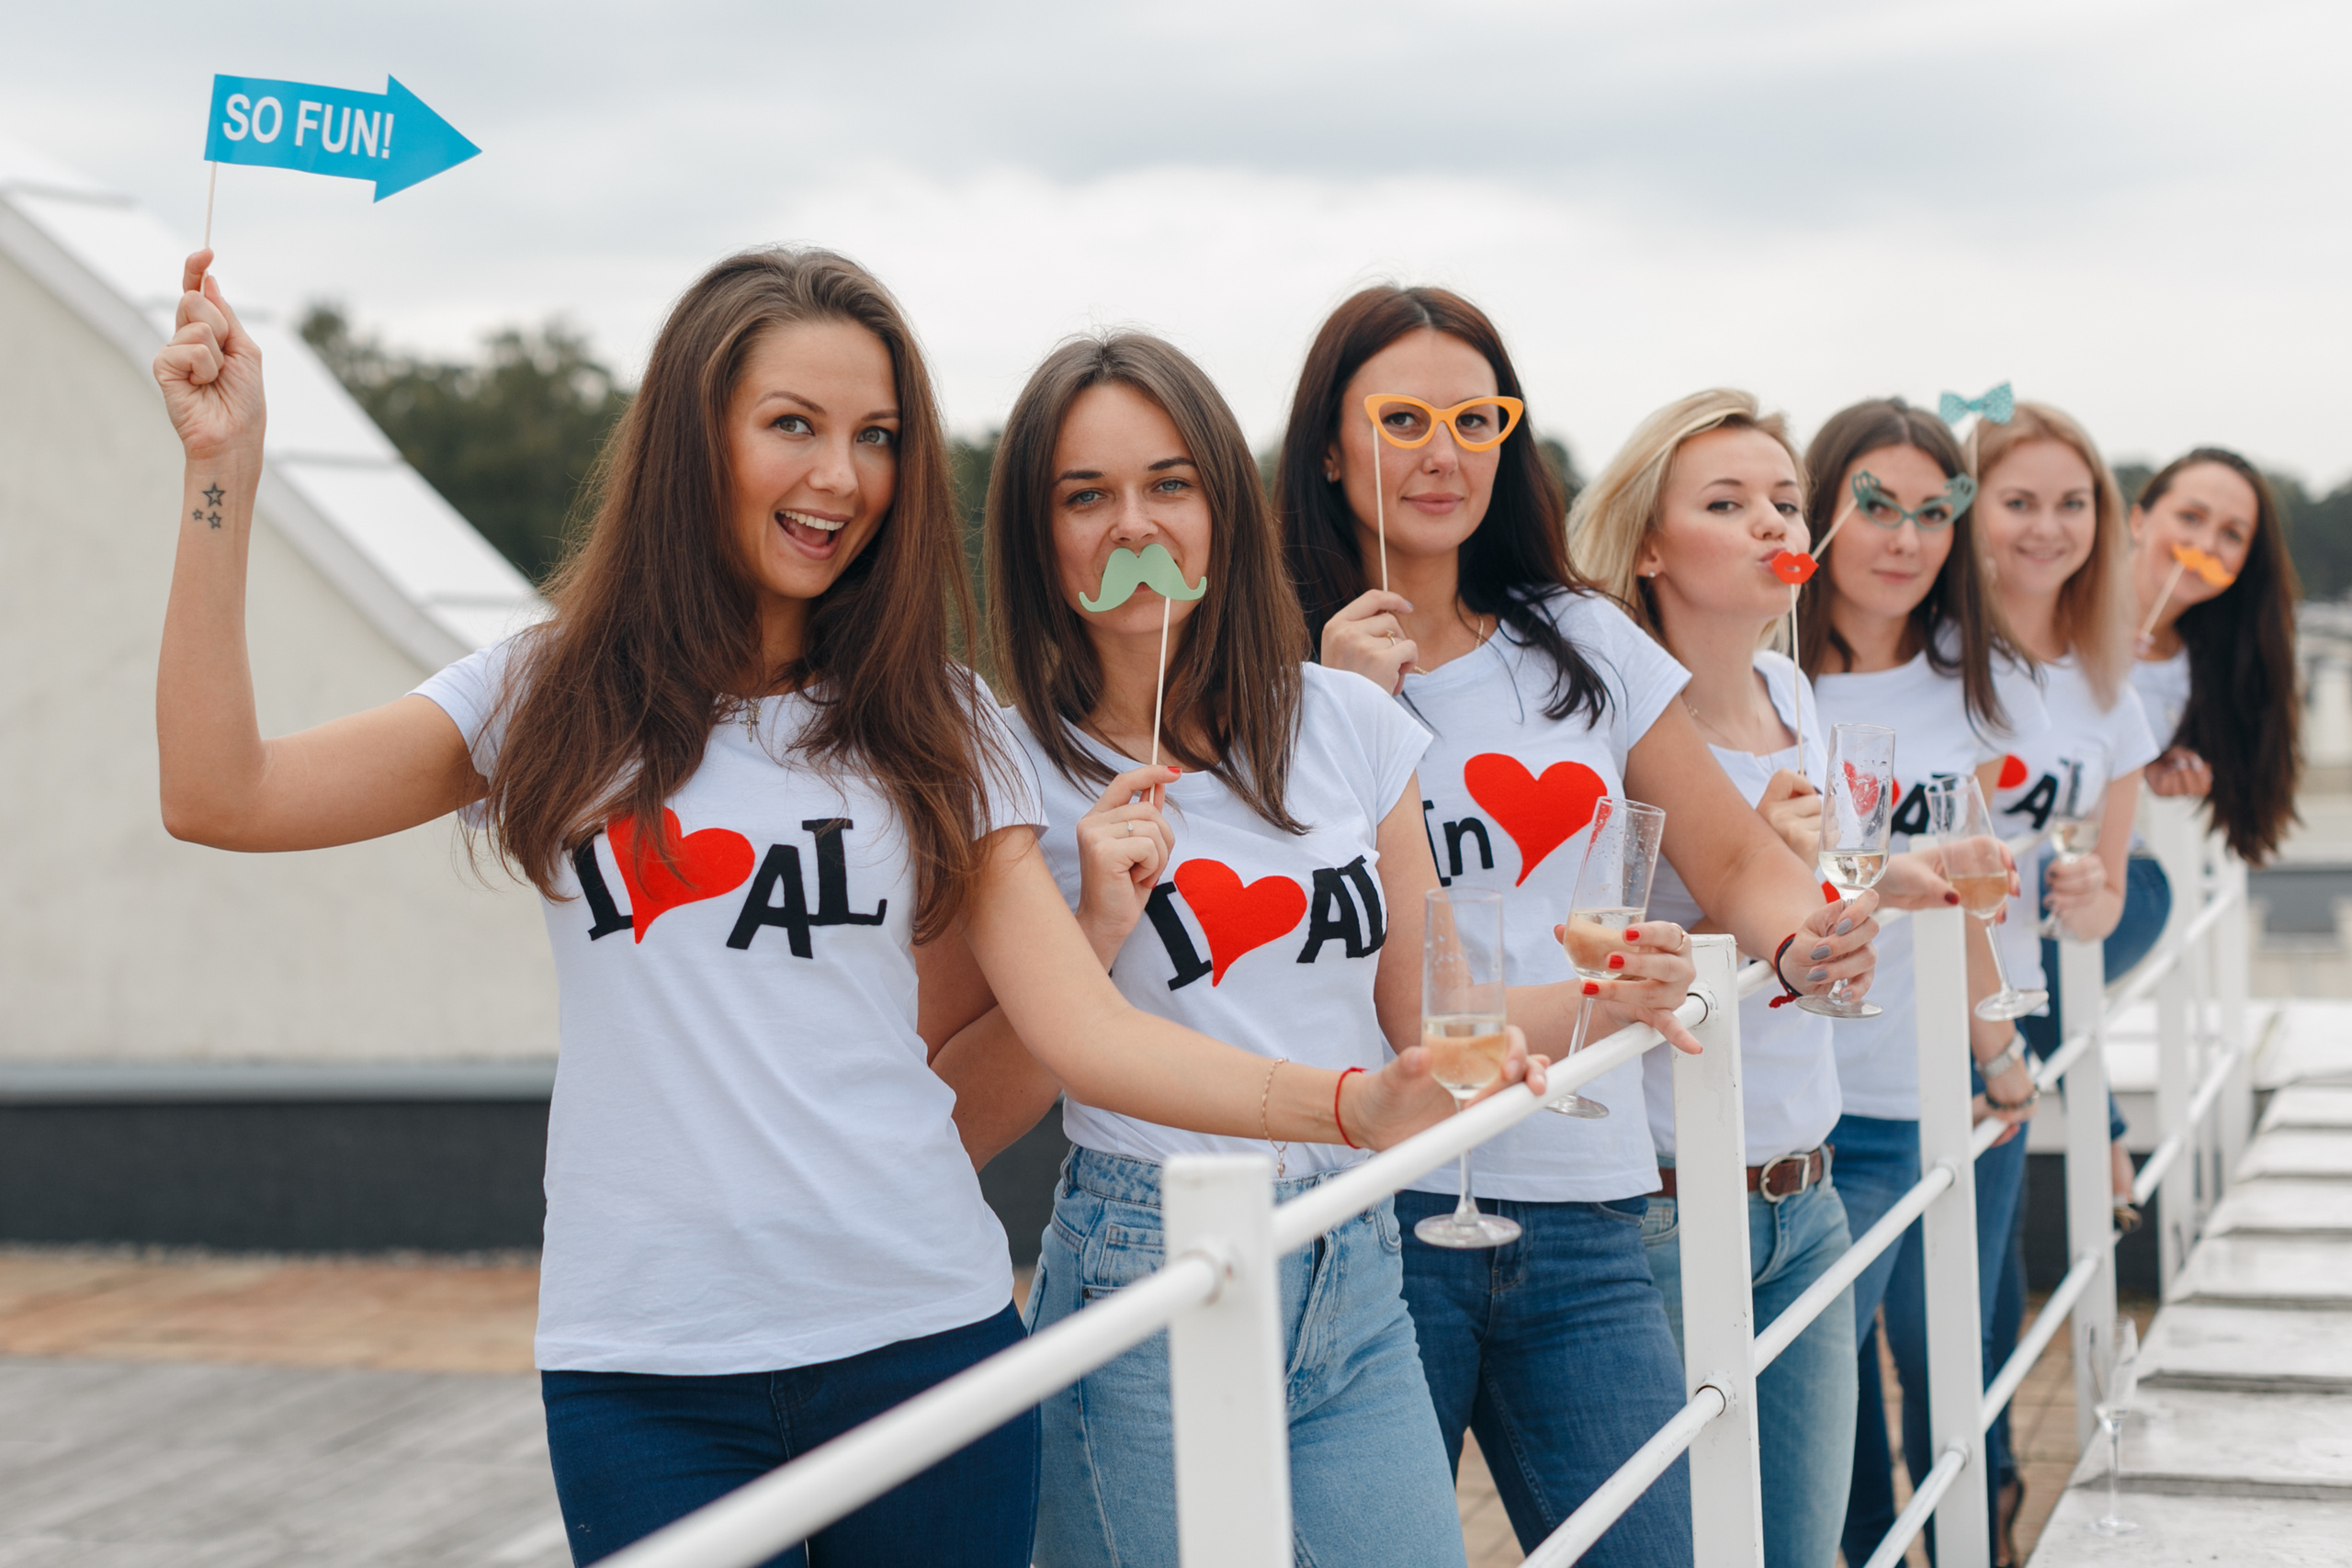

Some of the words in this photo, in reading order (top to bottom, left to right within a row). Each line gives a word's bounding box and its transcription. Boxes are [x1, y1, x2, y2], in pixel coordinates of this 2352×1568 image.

[222, 93, 283, 143] SO
[294, 99, 395, 160] FUN!
[726, 818, 888, 959] AL
[1422, 799, 1494, 887] n
[1144, 881, 1213, 991] I
